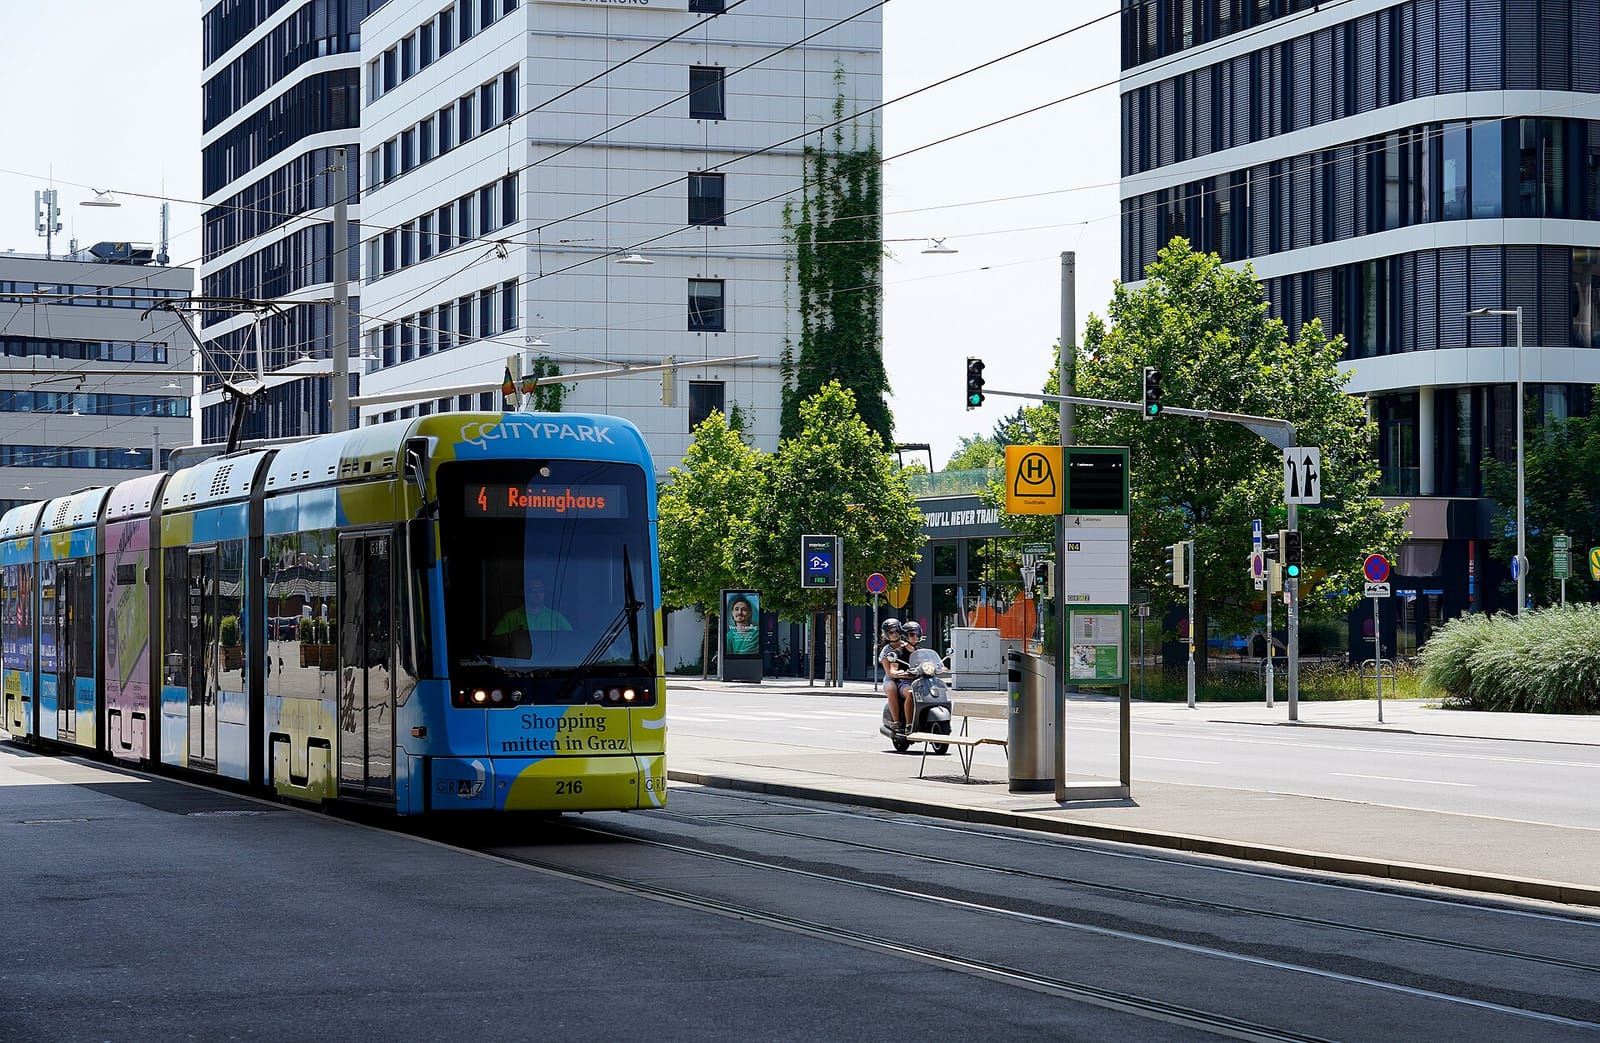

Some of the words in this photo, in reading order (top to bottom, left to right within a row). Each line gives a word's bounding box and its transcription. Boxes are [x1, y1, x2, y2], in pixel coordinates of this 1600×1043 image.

[478, 422, 615, 446] CITYPARK
[1027, 459, 1043, 478] H
[476, 486, 488, 512] 4
[508, 487, 606, 513] Reininghaus
[951, 510, 975, 526] NEVER
[1074, 517, 1081, 526] 4
[1068, 543, 1080, 551] N4
[521, 713, 607, 732] Shopping
[502, 738, 562, 753] mitten
[566, 736, 583, 751] in
[588, 735, 628, 751] Graz
[555, 780, 583, 795] 216
